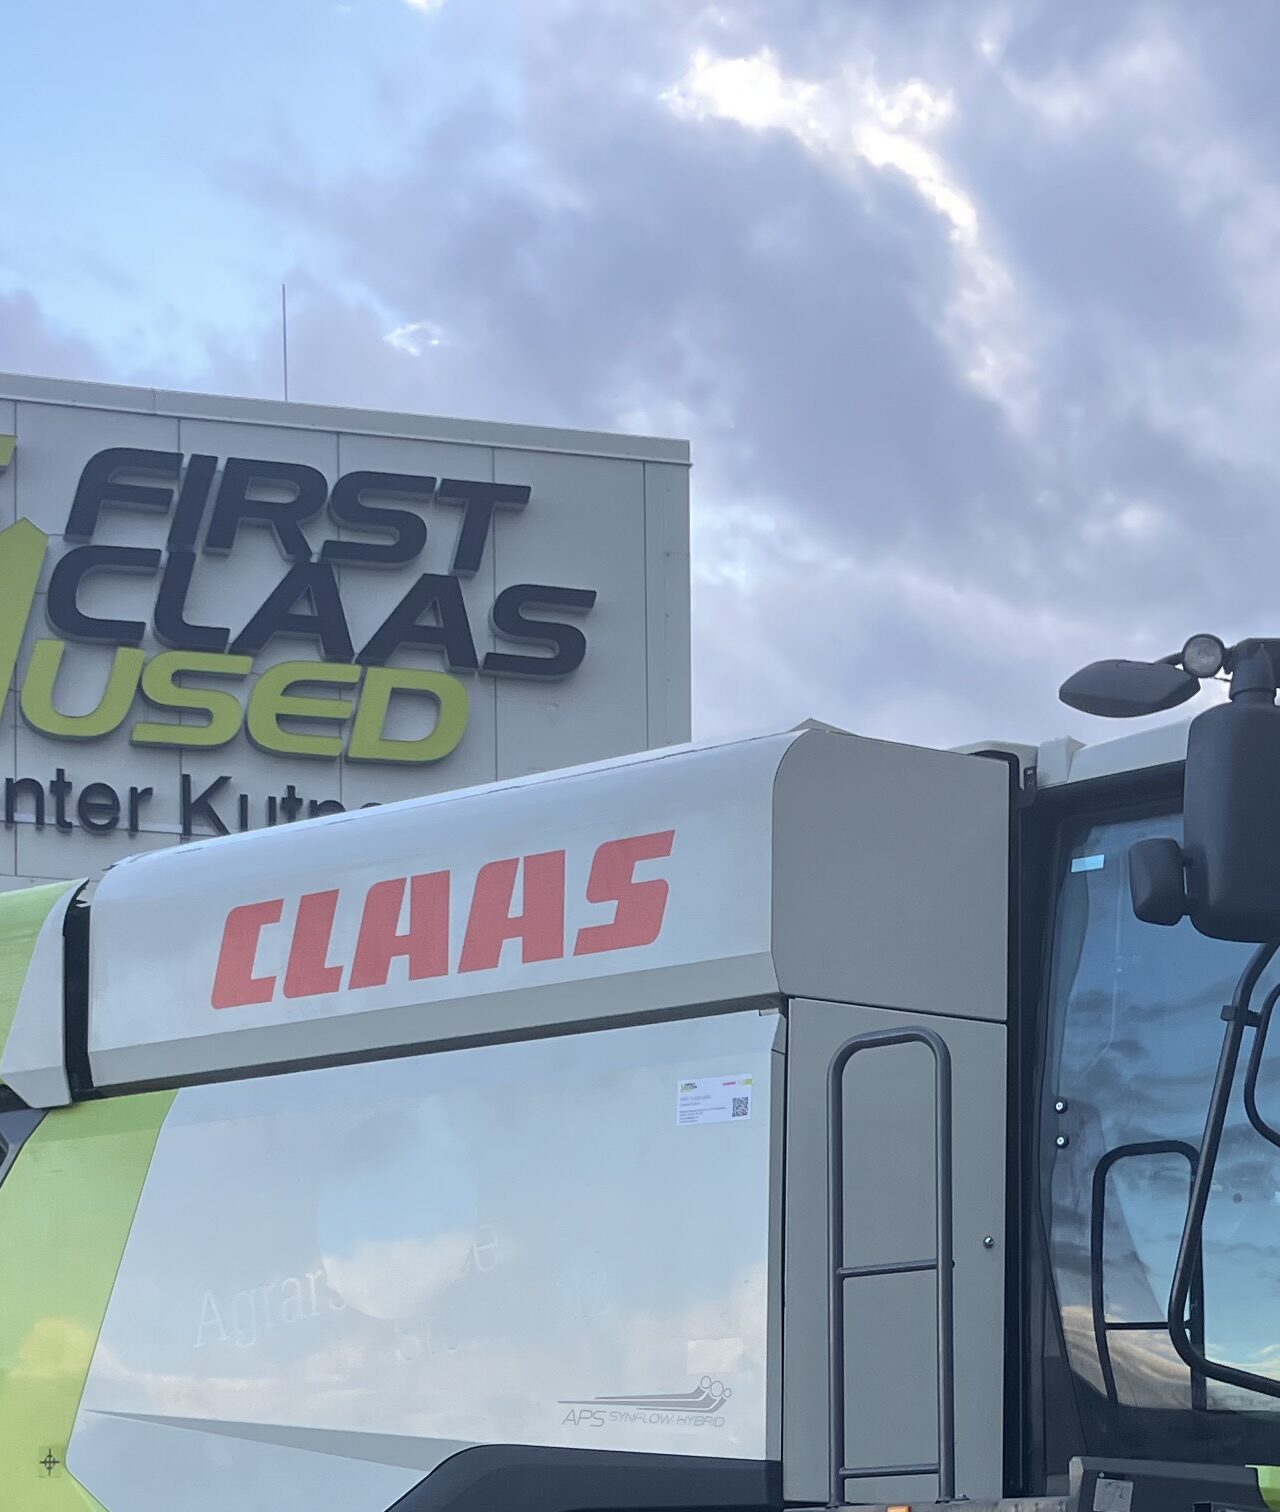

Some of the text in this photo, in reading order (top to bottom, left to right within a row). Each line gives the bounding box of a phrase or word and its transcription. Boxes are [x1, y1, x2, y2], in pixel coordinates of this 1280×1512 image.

[64, 447, 532, 577] FIRST
[46, 545, 597, 681] CLAAS
[20, 639, 470, 765] USED
[211, 829, 676, 1010] CLAAS
[562, 1409, 726, 1428] APS SYNFLOW HYBRID
